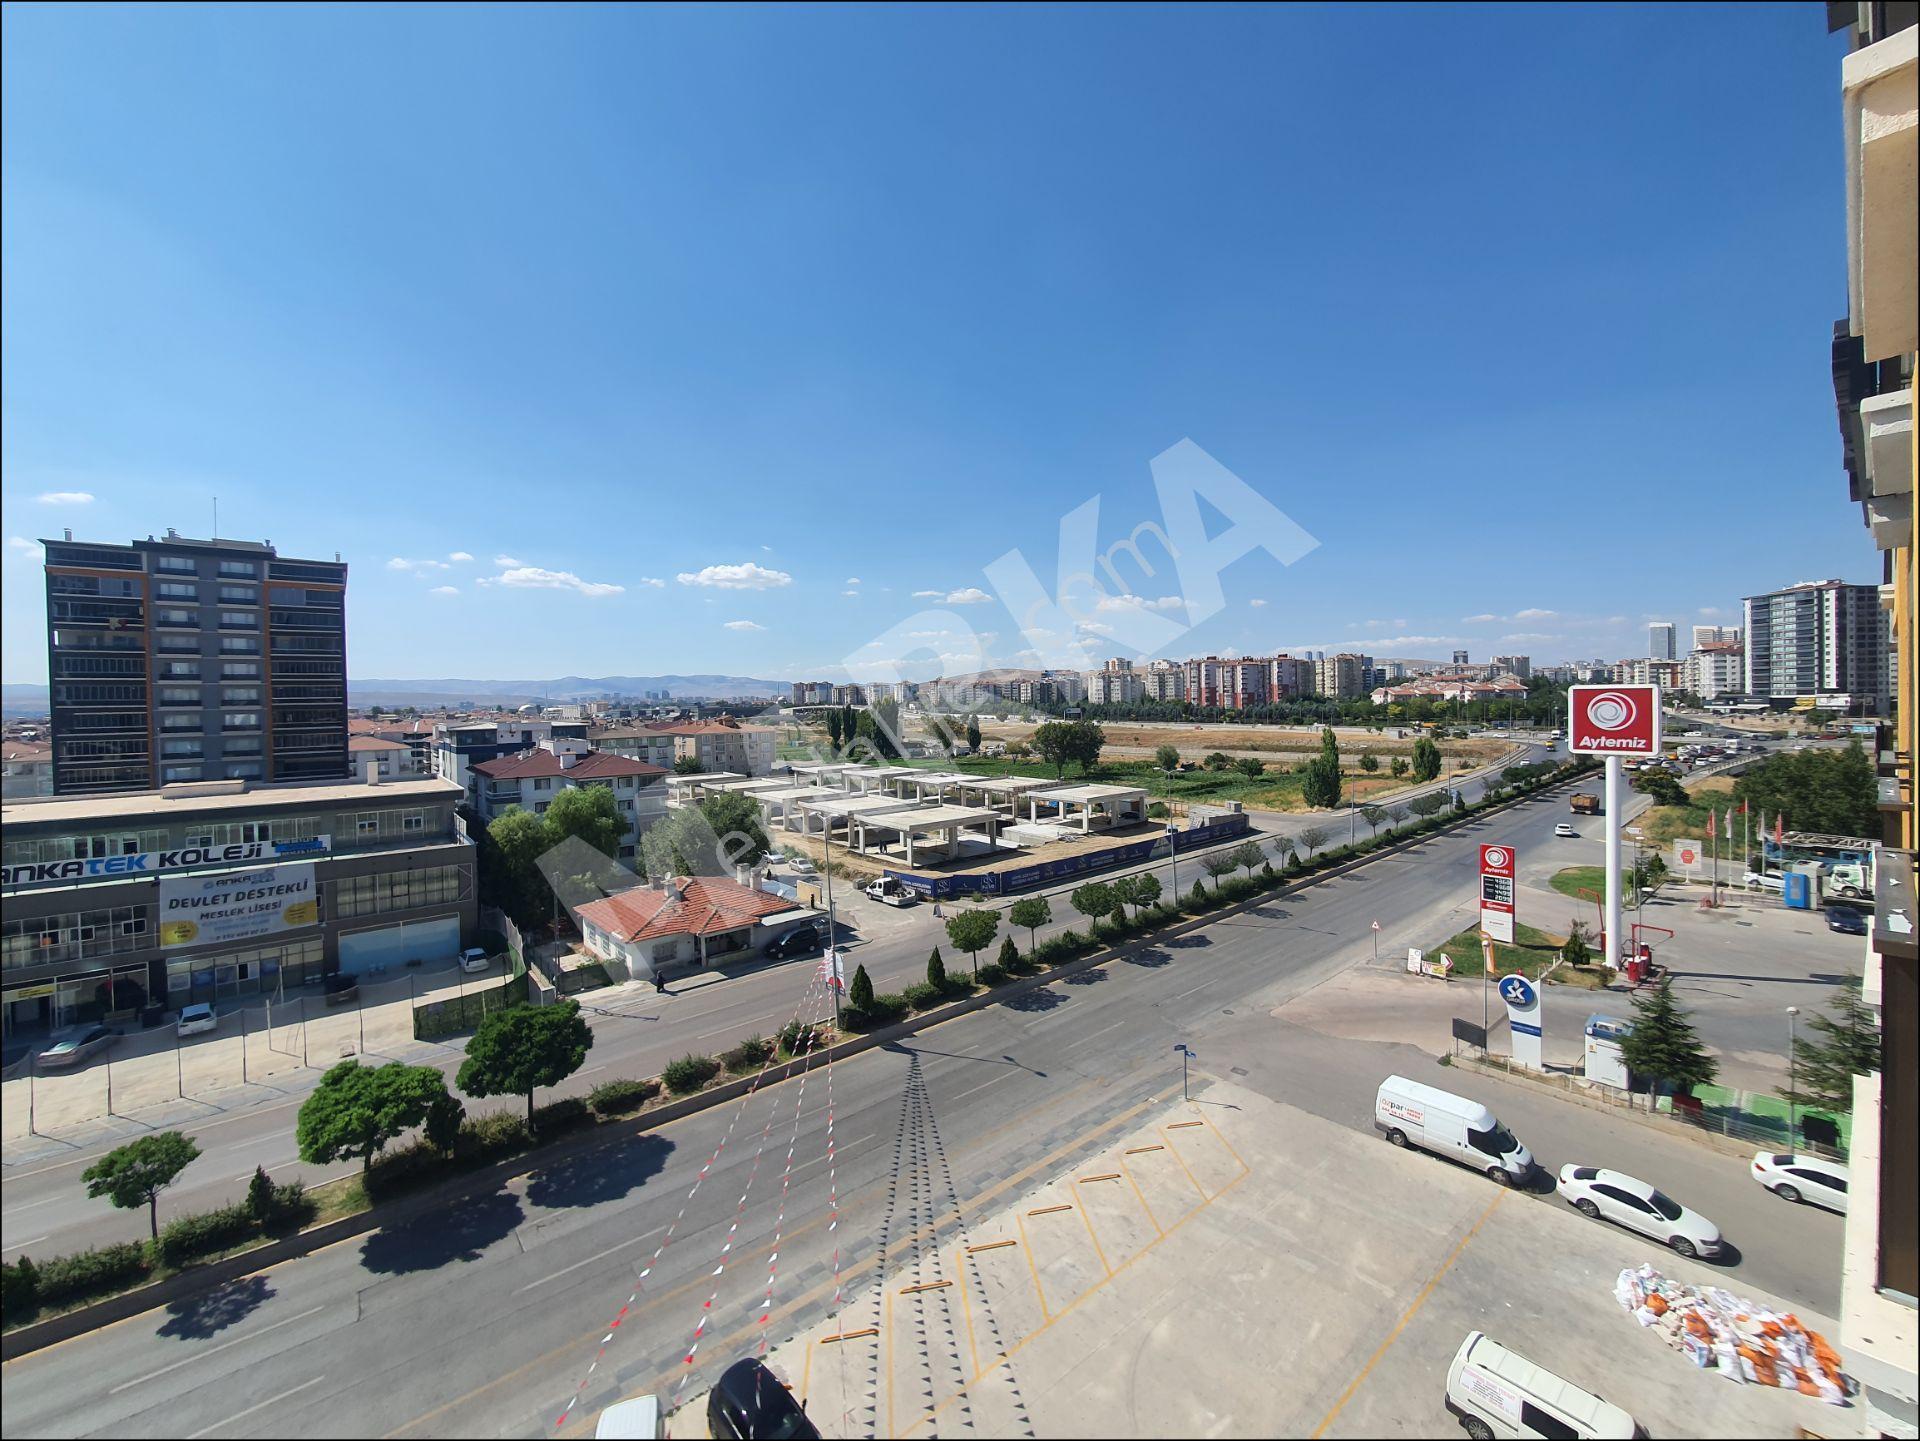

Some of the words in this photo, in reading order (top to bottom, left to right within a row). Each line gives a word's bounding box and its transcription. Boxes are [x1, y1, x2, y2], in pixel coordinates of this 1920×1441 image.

[1579, 736, 1646, 749] Aytemiz
[168, 893, 231, 910] DEVLET
[235, 878, 308, 902] DESTEKLİ
[200, 907, 245, 920] MESLEK
